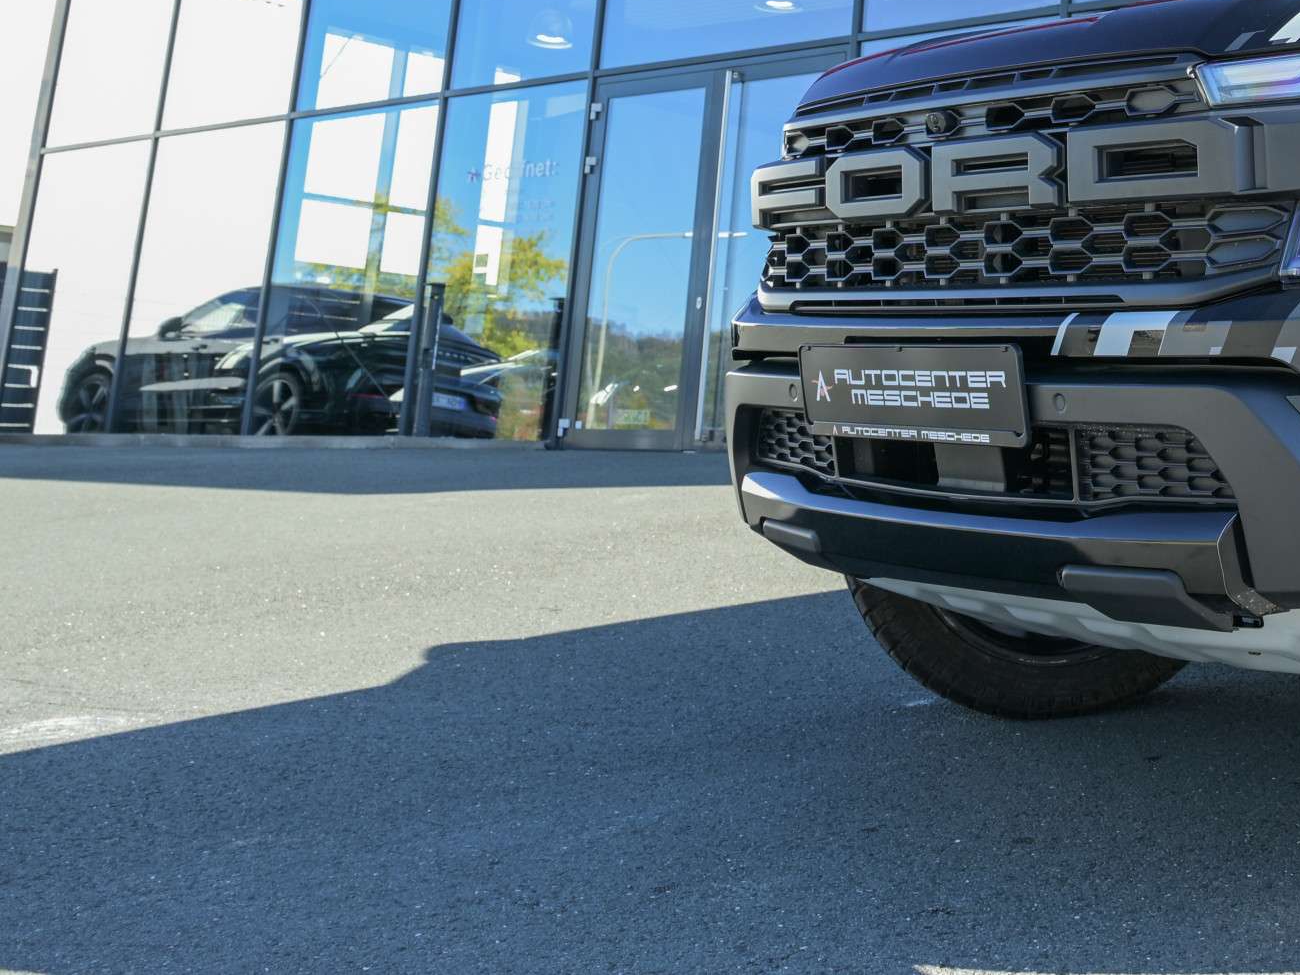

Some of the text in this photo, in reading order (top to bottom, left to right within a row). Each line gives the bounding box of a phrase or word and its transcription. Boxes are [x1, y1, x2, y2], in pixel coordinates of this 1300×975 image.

[751, 117, 1240, 231] FORD
[834, 369, 1006, 388] AUTOCENTER
[851, 389, 990, 409] MESCHEDE
[842, 426, 917, 440] AUTOCENTER
[921, 430, 990, 443] MESCHEDE
